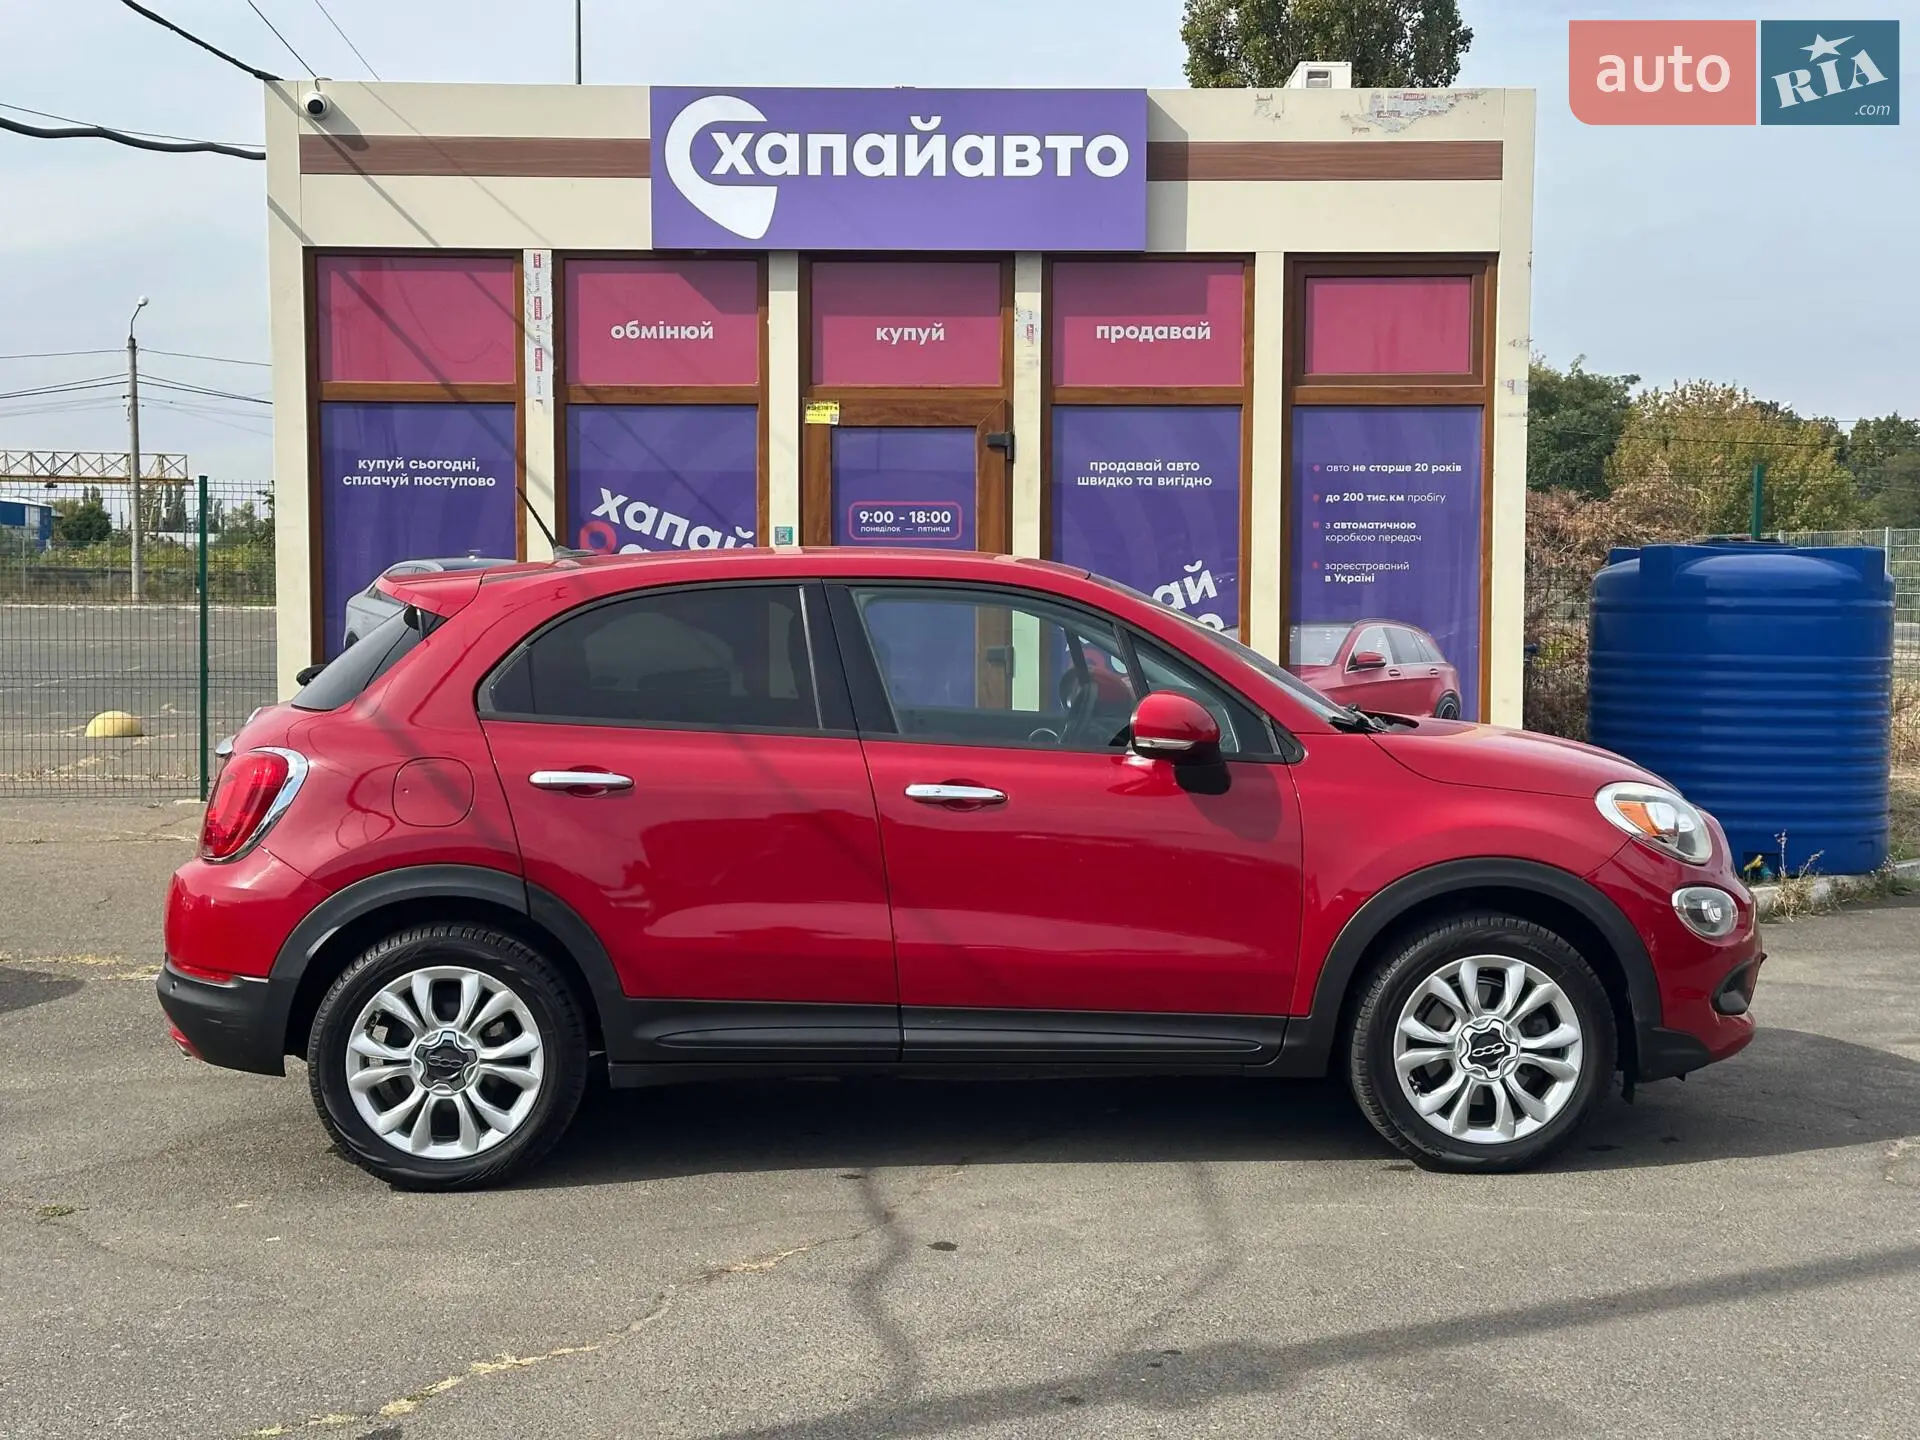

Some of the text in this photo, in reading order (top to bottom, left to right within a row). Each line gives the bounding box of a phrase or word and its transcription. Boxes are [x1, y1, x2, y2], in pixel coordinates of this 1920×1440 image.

[710, 115, 1130, 178] хапайавто
[610, 320, 714, 341] обмінюй
[876, 322, 945, 344] купуй
[1096, 322, 1212, 343] продавай
[357, 456, 480, 474] купуй сьогодні,
[1089, 458, 1200, 474] продавай авто
[1326, 462, 1462, 474] авто не старше 20 років
[342, 473, 496, 489] сплачуй поступово
[1077, 474, 1213, 489] швидко та вигідно
[1325, 493, 1341, 503] до
[1343, 493, 1364, 502] 200
[1407, 493, 1446, 504] пробігу
[859, 510, 894, 523] 9:00
[909, 510, 952, 523] 18:00
[860, 525, 901, 533] понеділок
[1325, 522, 1417, 530] з автоматичною
[1325, 533, 1422, 543] коробкою передач
[1324, 561, 1410, 572] зареєстрований
[1324, 572, 1375, 584] в Україні
